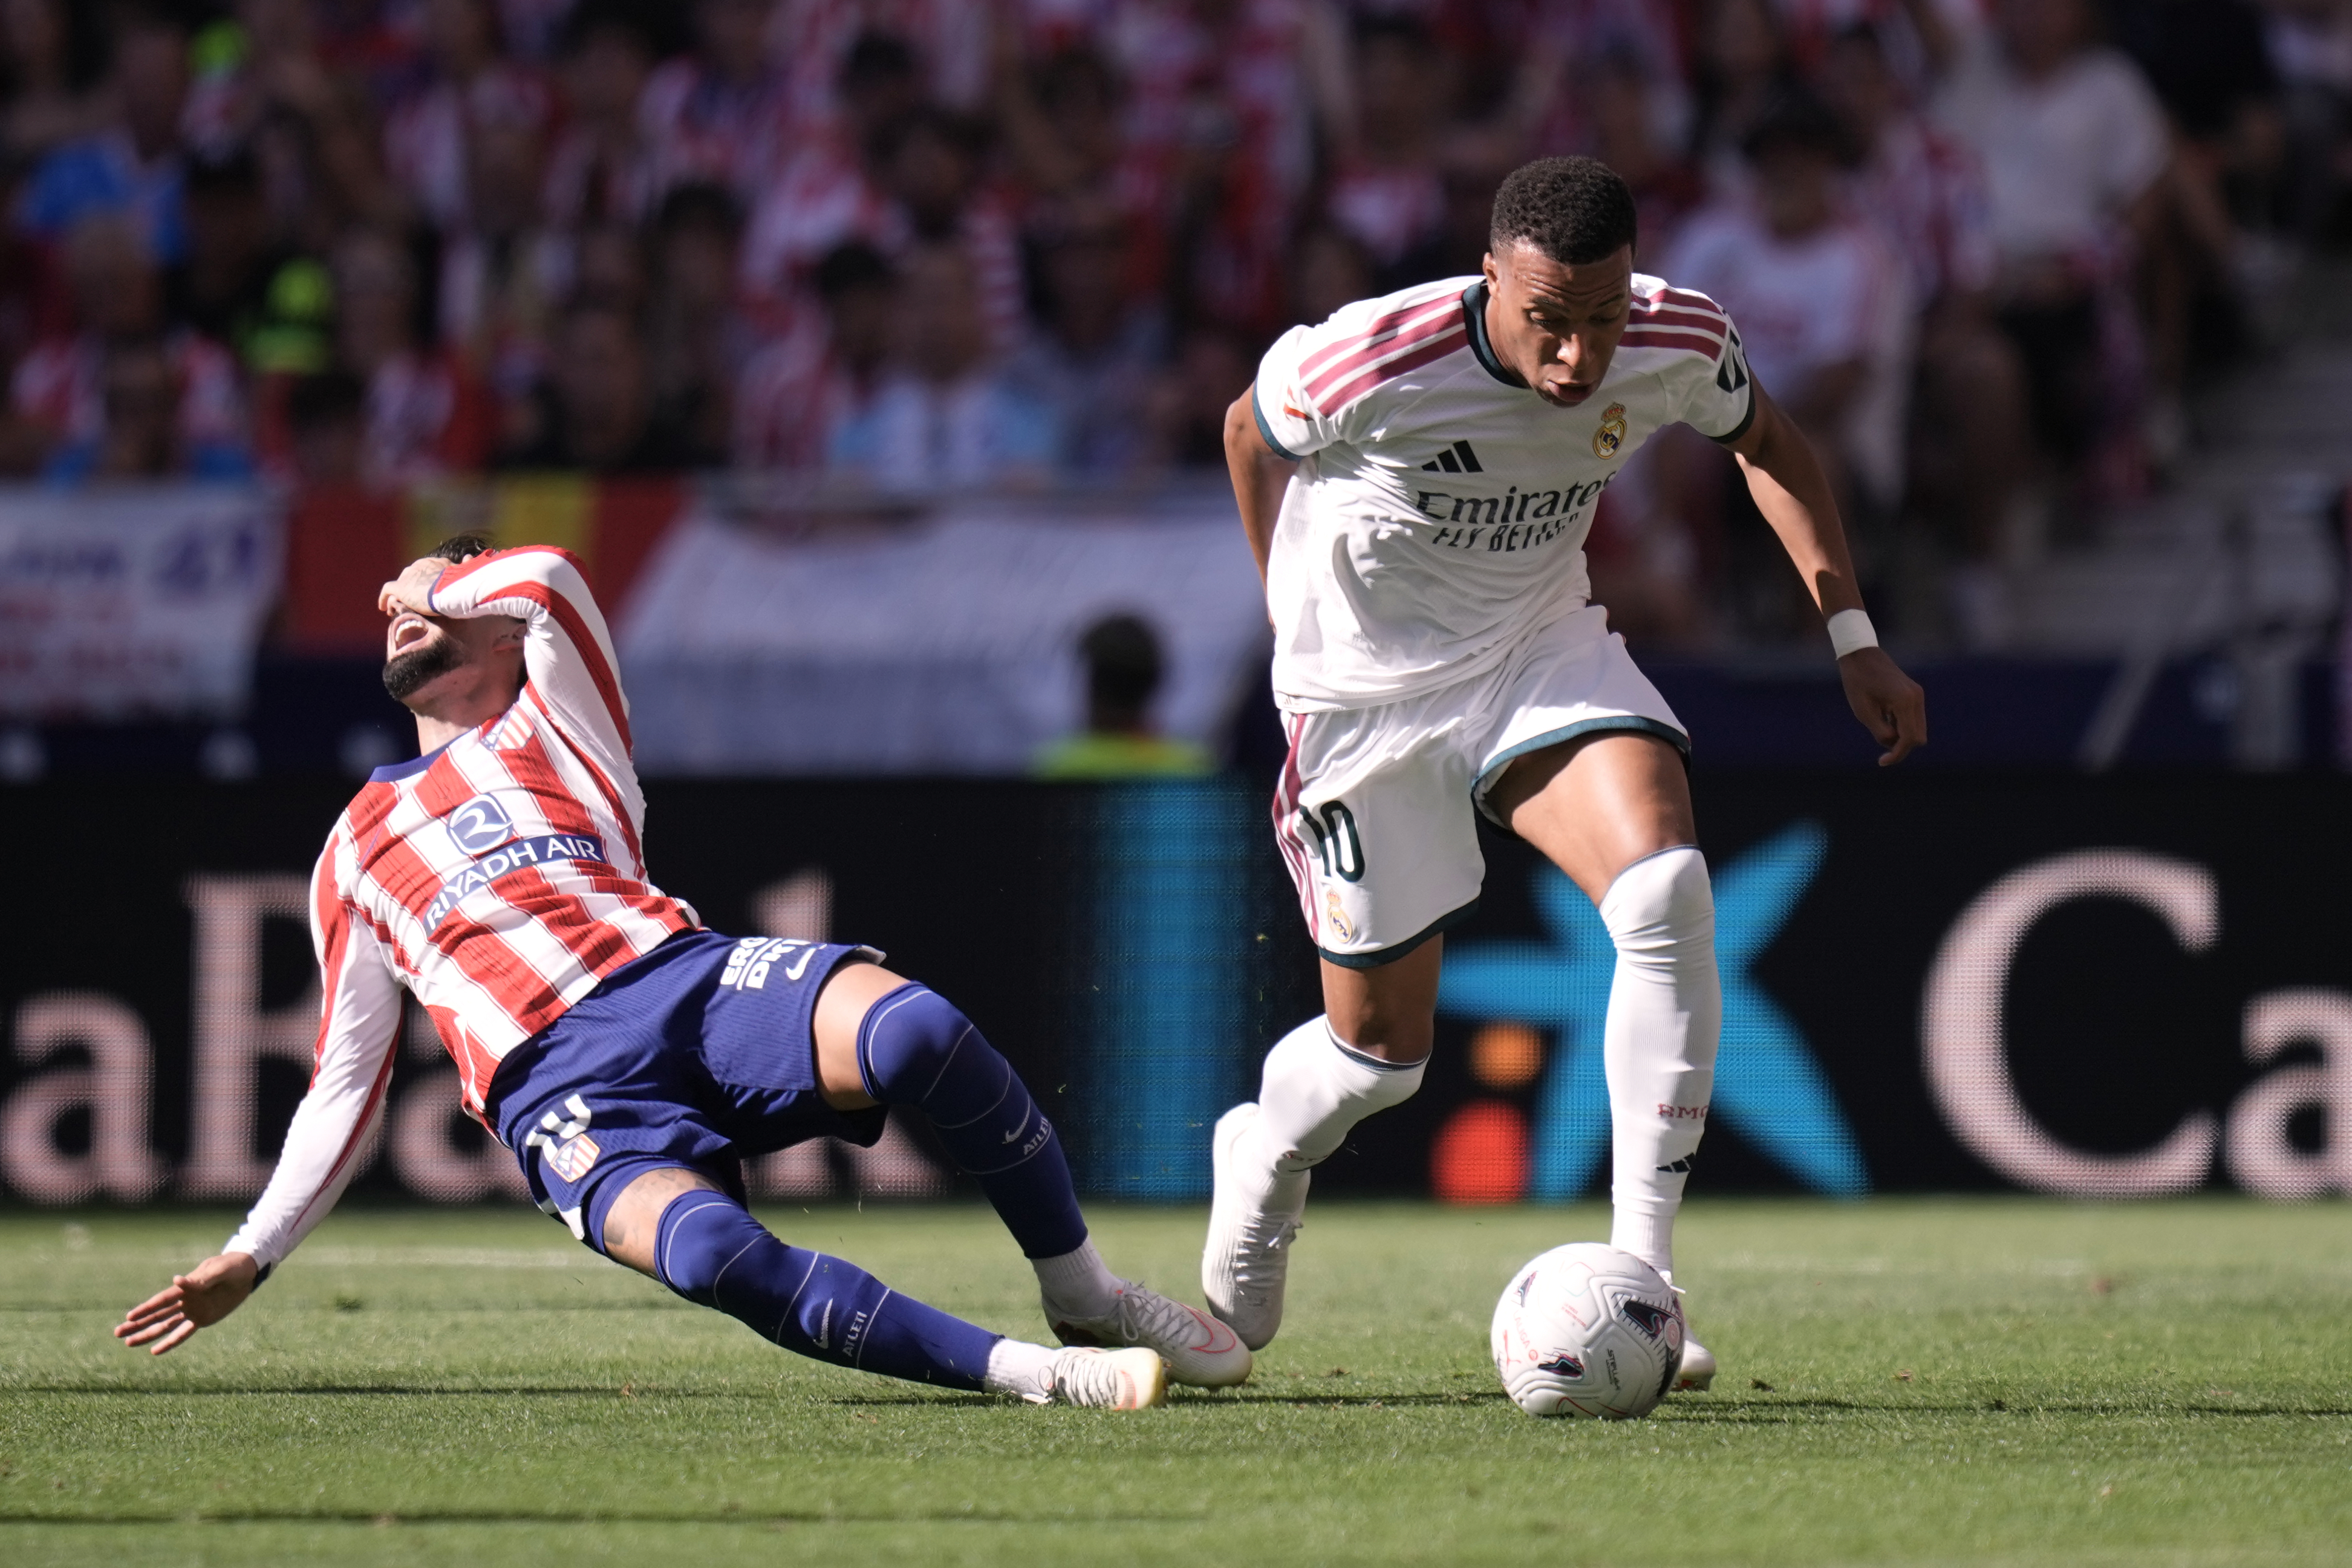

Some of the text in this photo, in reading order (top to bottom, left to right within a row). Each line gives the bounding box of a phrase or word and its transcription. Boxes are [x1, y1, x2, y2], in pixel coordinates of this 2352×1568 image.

[1432, 527, 1487, 549] FLY
[1299, 800, 1366, 883] 10
[426, 837, 602, 931] RIYADH AIR
[842, 1310, 868, 1358] ATLETI
